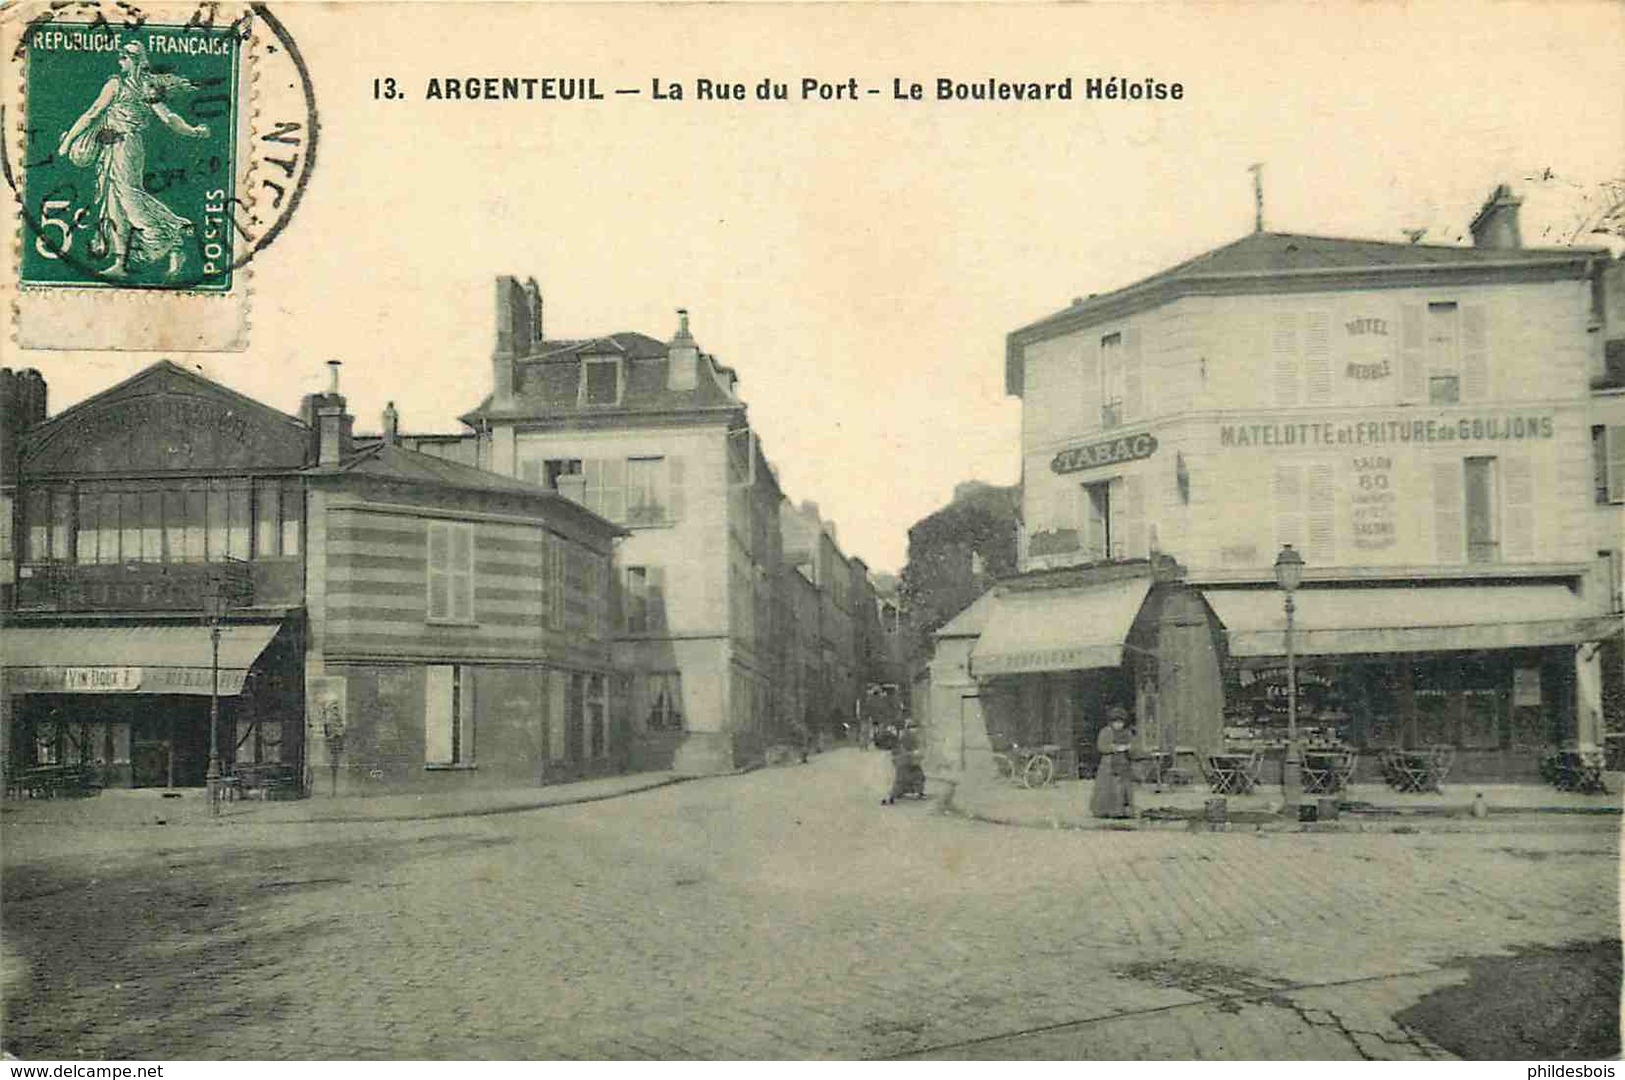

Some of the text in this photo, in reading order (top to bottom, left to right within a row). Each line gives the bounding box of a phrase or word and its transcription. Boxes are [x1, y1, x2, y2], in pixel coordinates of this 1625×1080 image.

[149, 35, 230, 55] FRANÇAISE
[375, 78, 404, 100] 13.
[426, 78, 604, 100] ARGENTEUIL
[653, 78, 683, 100] La
[697, 78, 746, 100] Rue
[756, 78, 788, 100] du
[802, 78, 858, 100] Port
[894, 78, 923, 100] Le
[937, 77, 1072, 100] Boulevard
[1086, 77, 1184, 100] Héloïse
[204, 189, 225, 275] POSTES
[1221, 424, 1335, 446] MATELOTTE
[1337, 426, 1354, 444] et
[1356, 420, 1437, 443] FRITURE
[1458, 416, 1553, 441] GOUJONS
[1056, 435, 1151, 471] TABAC
